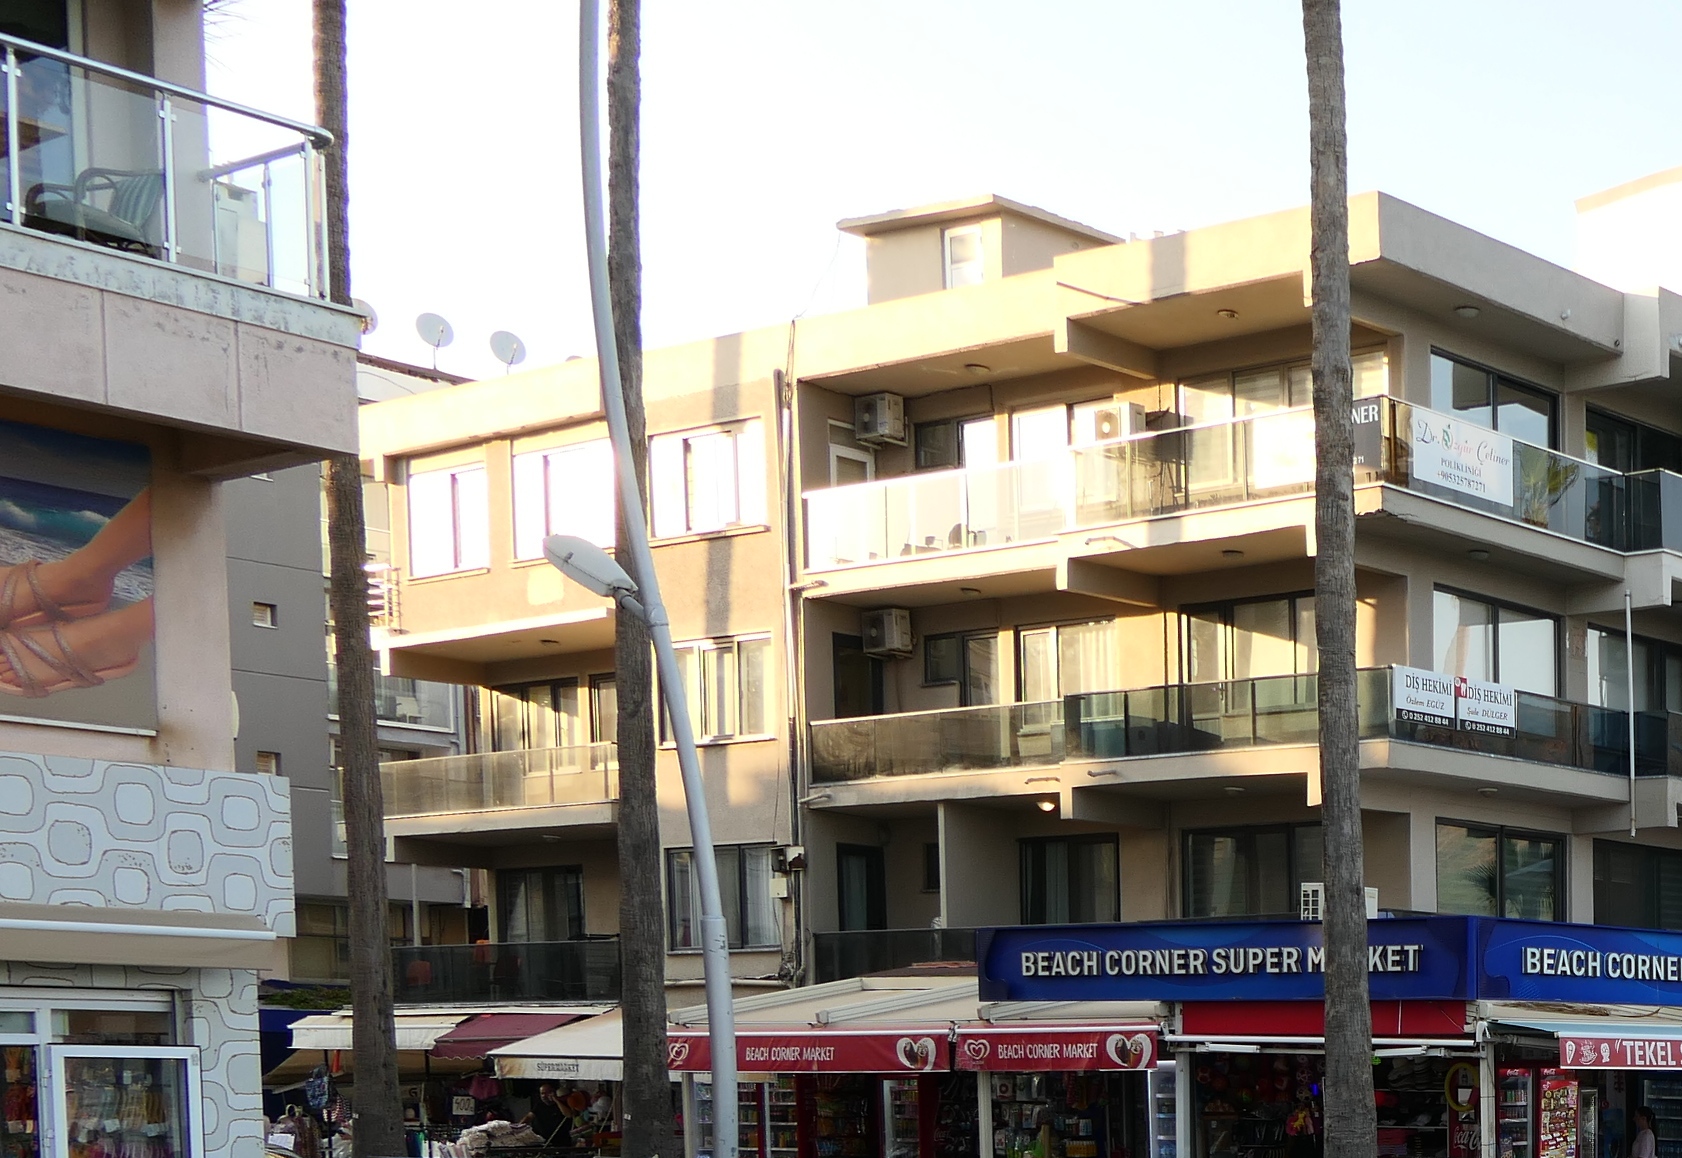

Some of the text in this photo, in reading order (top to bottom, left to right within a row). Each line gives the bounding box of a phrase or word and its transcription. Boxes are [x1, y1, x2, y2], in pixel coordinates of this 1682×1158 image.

[1416, 419, 1440, 444] Dr.
[1405, 673, 1452, 697] DİŞ HEKİMİ
[1468, 685, 1513, 707] DİŞ HEKİMİ
[1021, 944, 1421, 977] BEACH CORNER SUPER MKET
[1524, 947, 1600, 978] BEACH
[746, 1046, 835, 1061] BEACH CORNER MARKET
[998, 1043, 1098, 1059] BEACH CORNER MARKET
[1623, 1041, 1676, 1067] TEKEL
